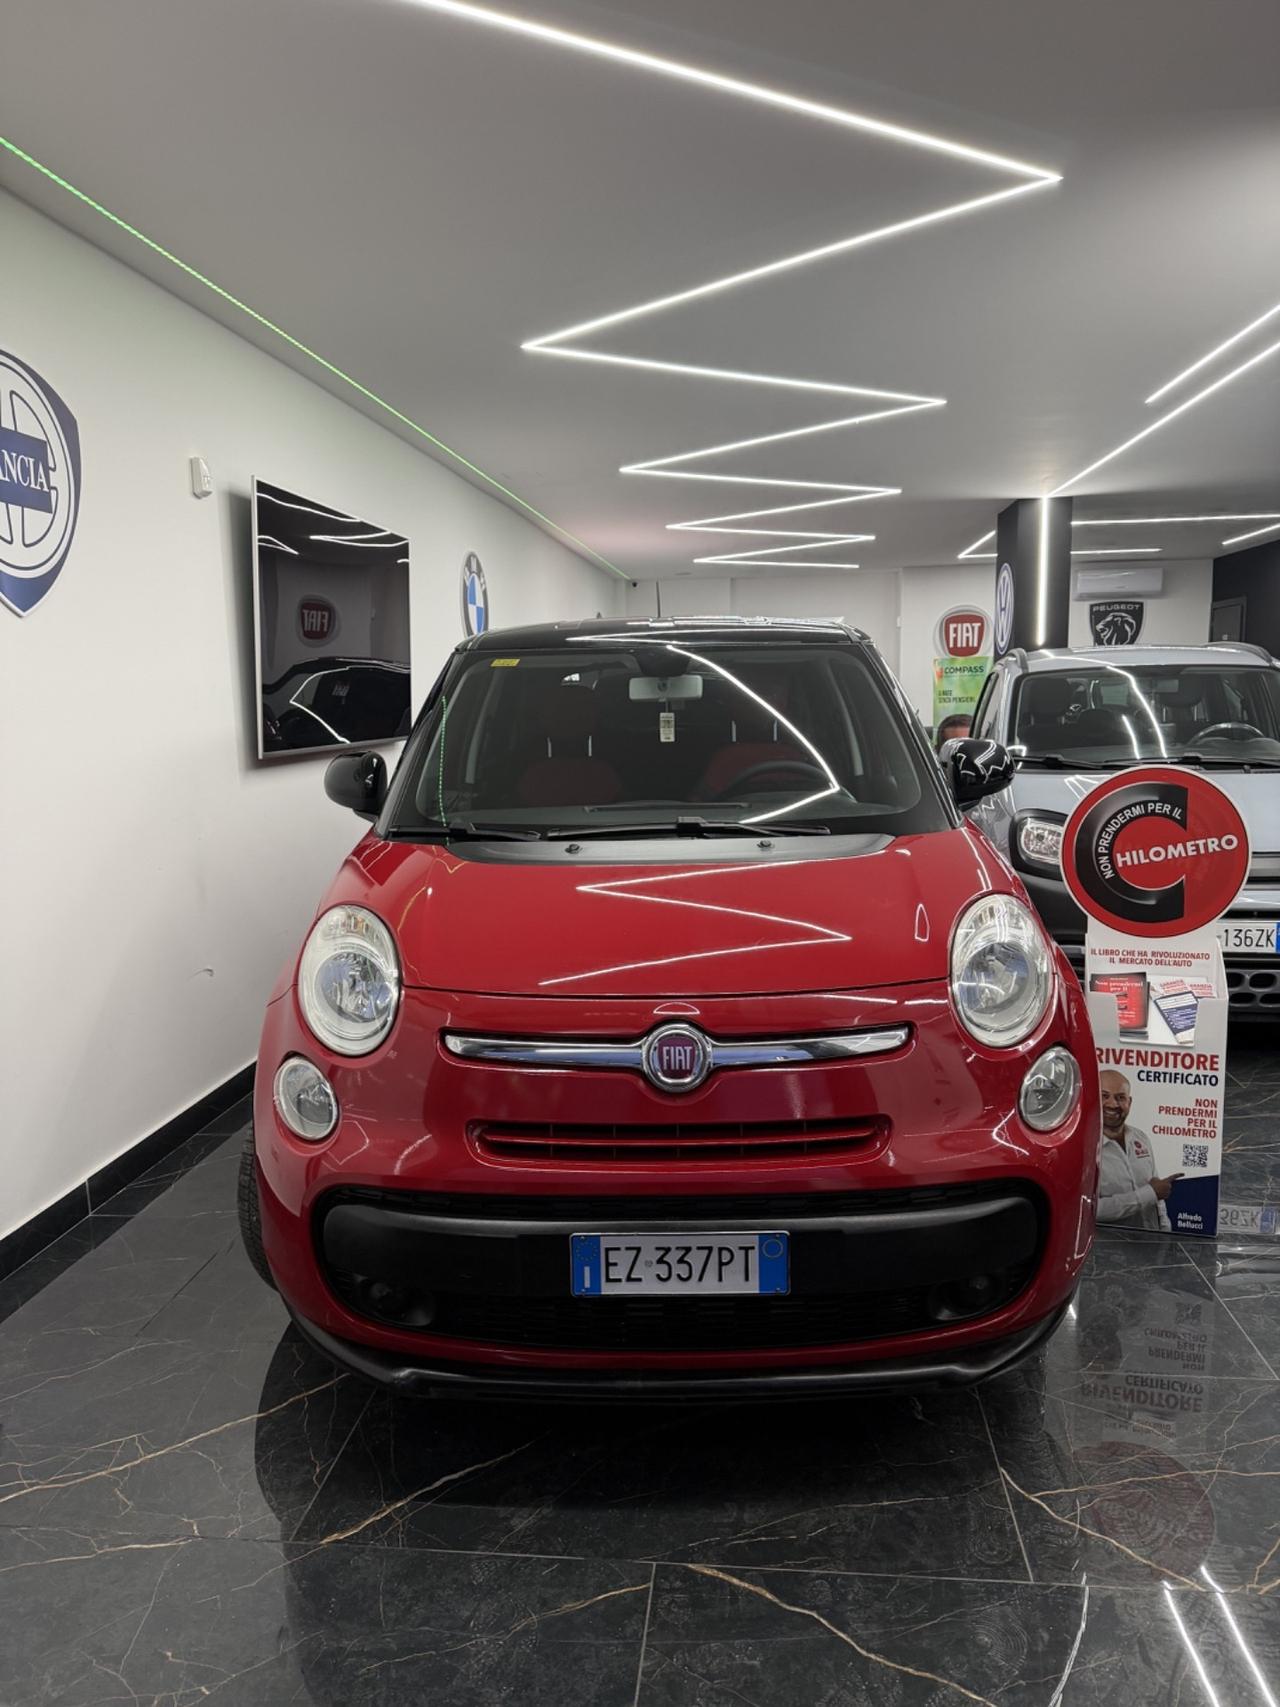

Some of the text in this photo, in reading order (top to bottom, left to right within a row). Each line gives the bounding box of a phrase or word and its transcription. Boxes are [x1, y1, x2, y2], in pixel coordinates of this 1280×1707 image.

[1093, 604, 1140, 612] PEUGEOT
[949, 623, 981, 648] FIAT
[944, 665, 984, 674] COMPASS
[1098, 802, 1183, 879] NON PRENDERMI PER IL
[1121, 949, 1136, 957] CHE
[1151, 950, 1210, 960] RIVOLUZIONATO
[1119, 957, 1153, 966] MERCATO
[1155, 959, 1192, 967] DELL'AUTO
[663, 1046, 693, 1070] FIAT
[1095, 1047, 1219, 1071] RIVENDITORE
[1137, 1070, 1218, 1086] CERTIFICATO
[1195, 1098, 1217, 1108] NON
[1158, 1106, 1217, 1118] PRENDERMI
[1187, 1118, 1206, 1128] PER
[1152, 1125, 1216, 1138] CHILOMETRO
[1177, 1212, 1202, 1221] Alfredo
[1177, 1221, 1203, 1229] Bellucci
